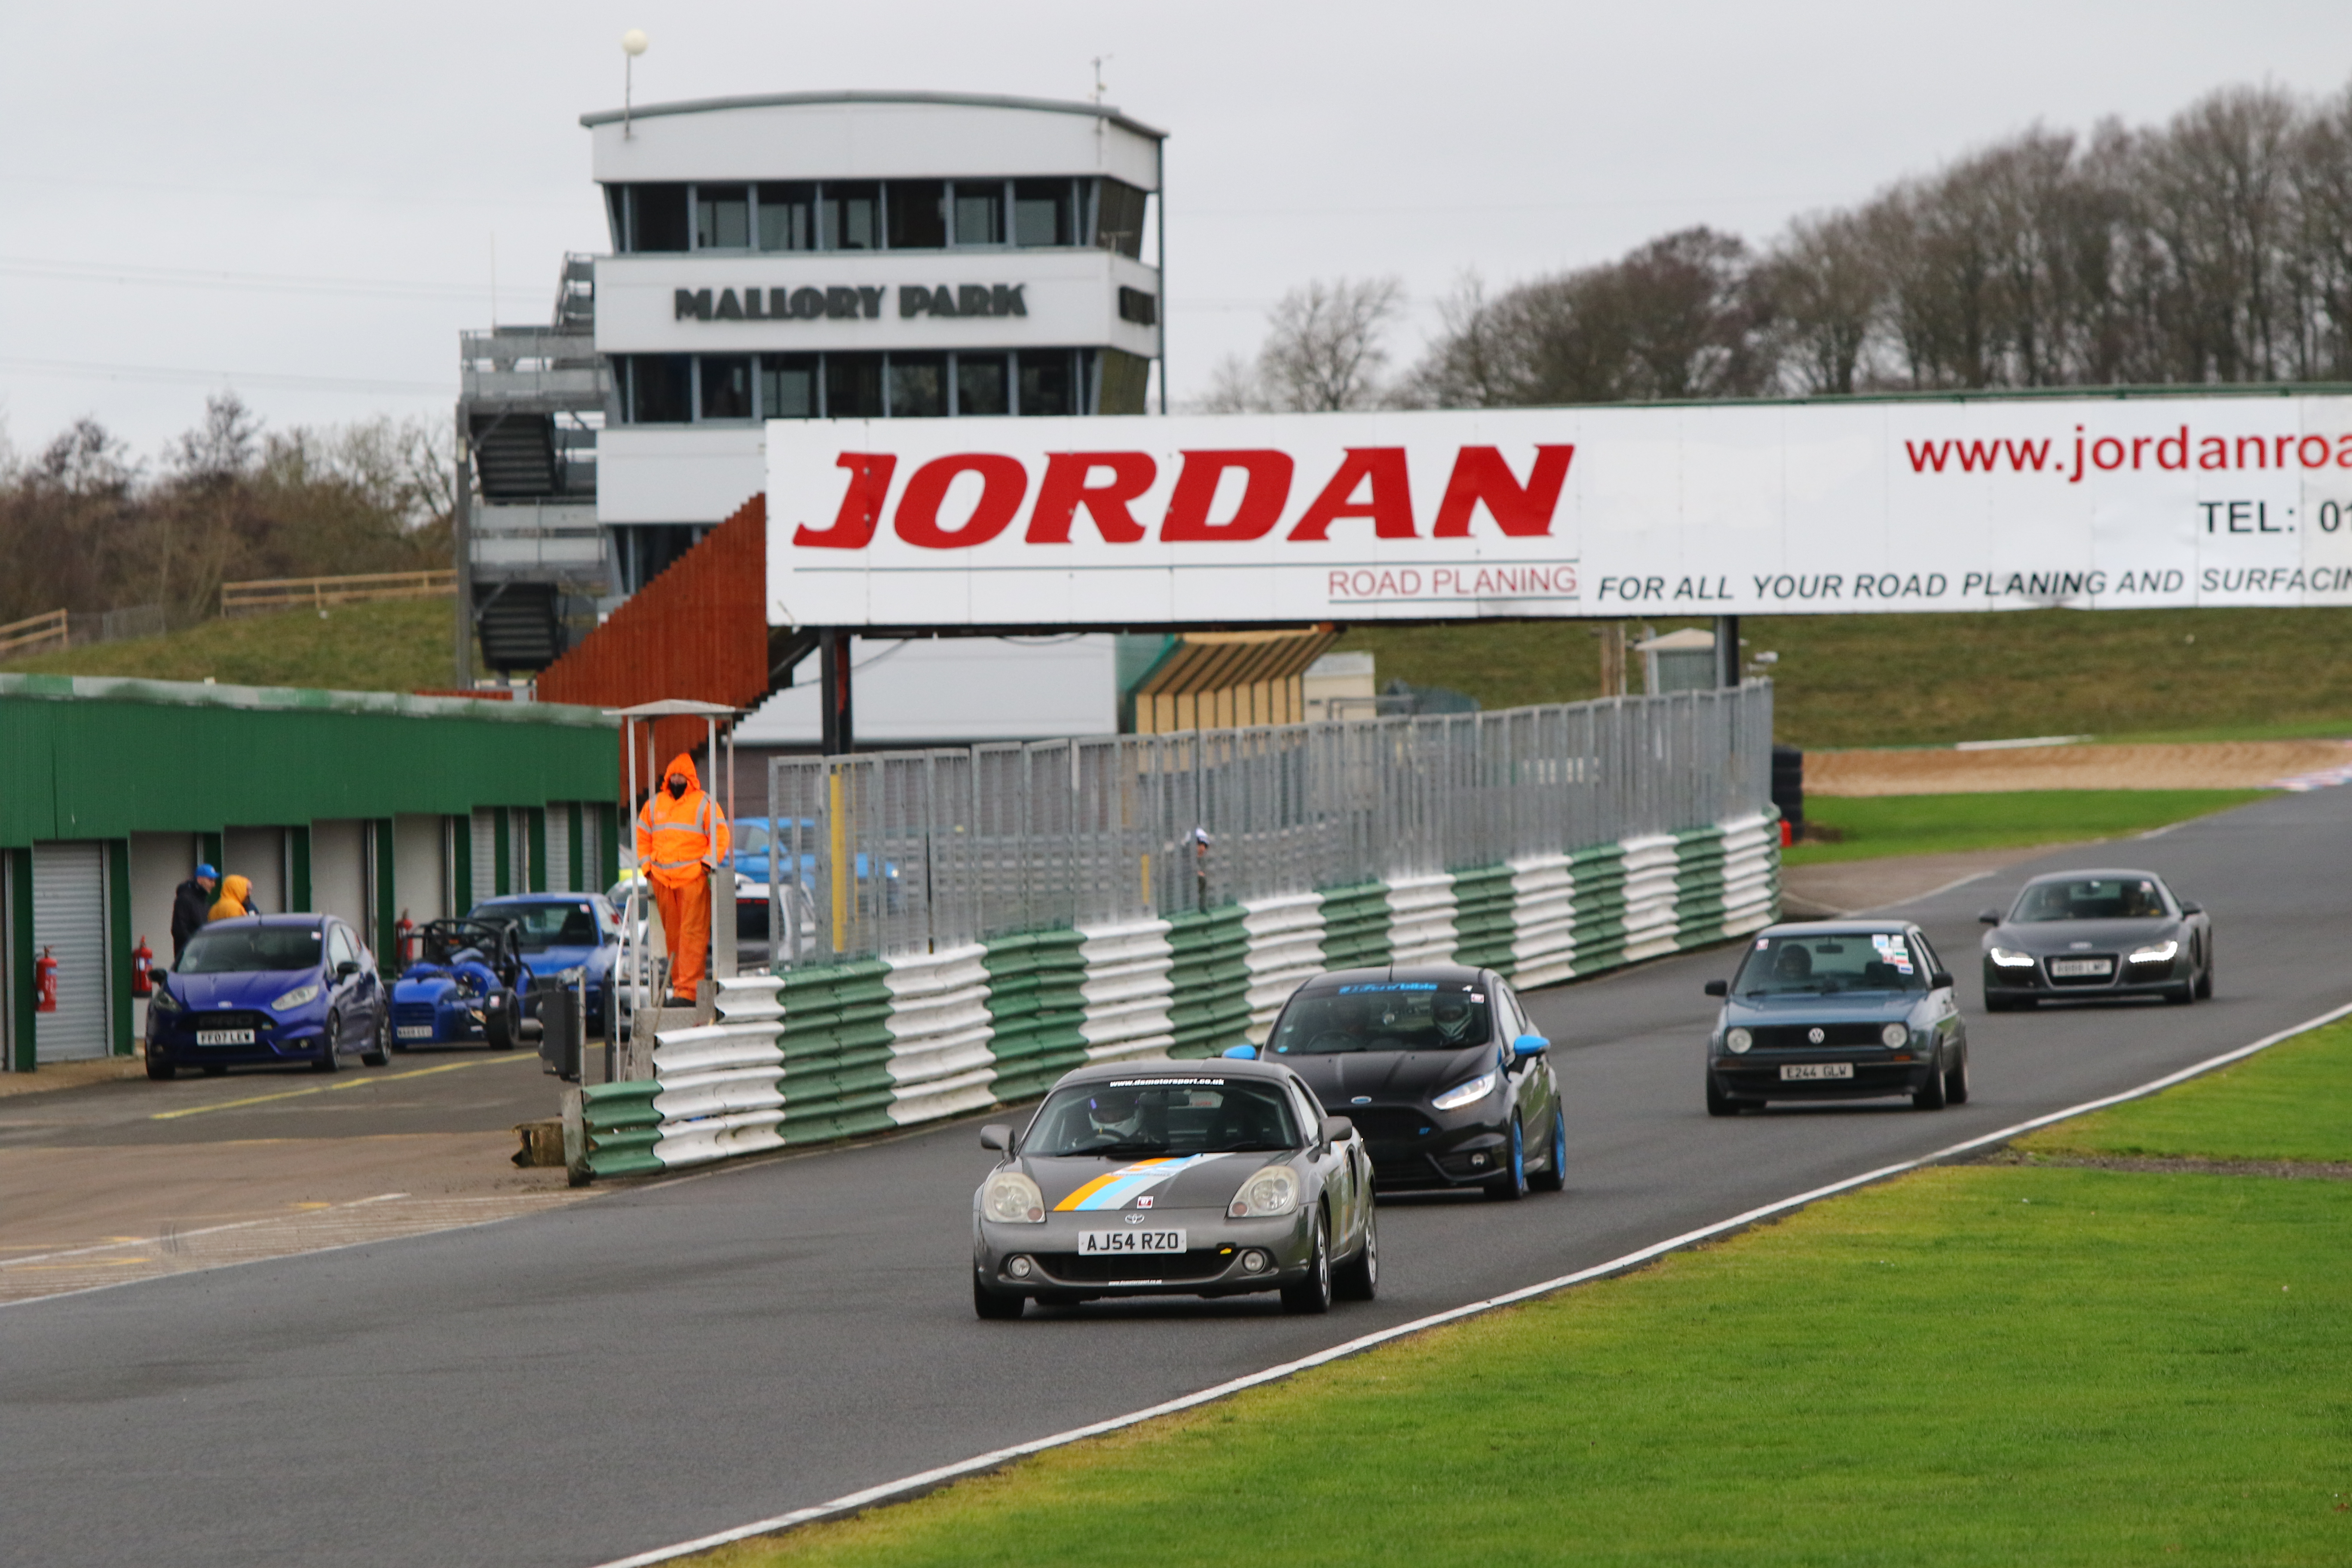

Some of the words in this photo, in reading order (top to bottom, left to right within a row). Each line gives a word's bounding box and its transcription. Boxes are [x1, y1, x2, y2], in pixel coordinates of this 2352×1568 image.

[674, 286, 885, 322] MALLORY
[898, 284, 1028, 320] PARK
[792, 444, 1575, 550] JORDAN
[2198, 500, 2295, 534] TEL:
[1329, 570, 1422, 595] ROAD
[1433, 567, 1577, 594] PLANING
[1598, 576, 1665, 601] FOR
[1673, 576, 1733, 600] ALL
[1753, 574, 1844, 600] YOUR
[1853, 573, 1948, 598] ROAD
[1962, 571, 2106, 597] PLANING
[2116, 570, 2184, 593] AND
[1787, 1066, 1816, 1078] E244
[1824, 1065, 1847, 1076] GLW
[1087, 1233, 1135, 1251] AJ54
[1142, 1233, 1178, 1250] RZO
